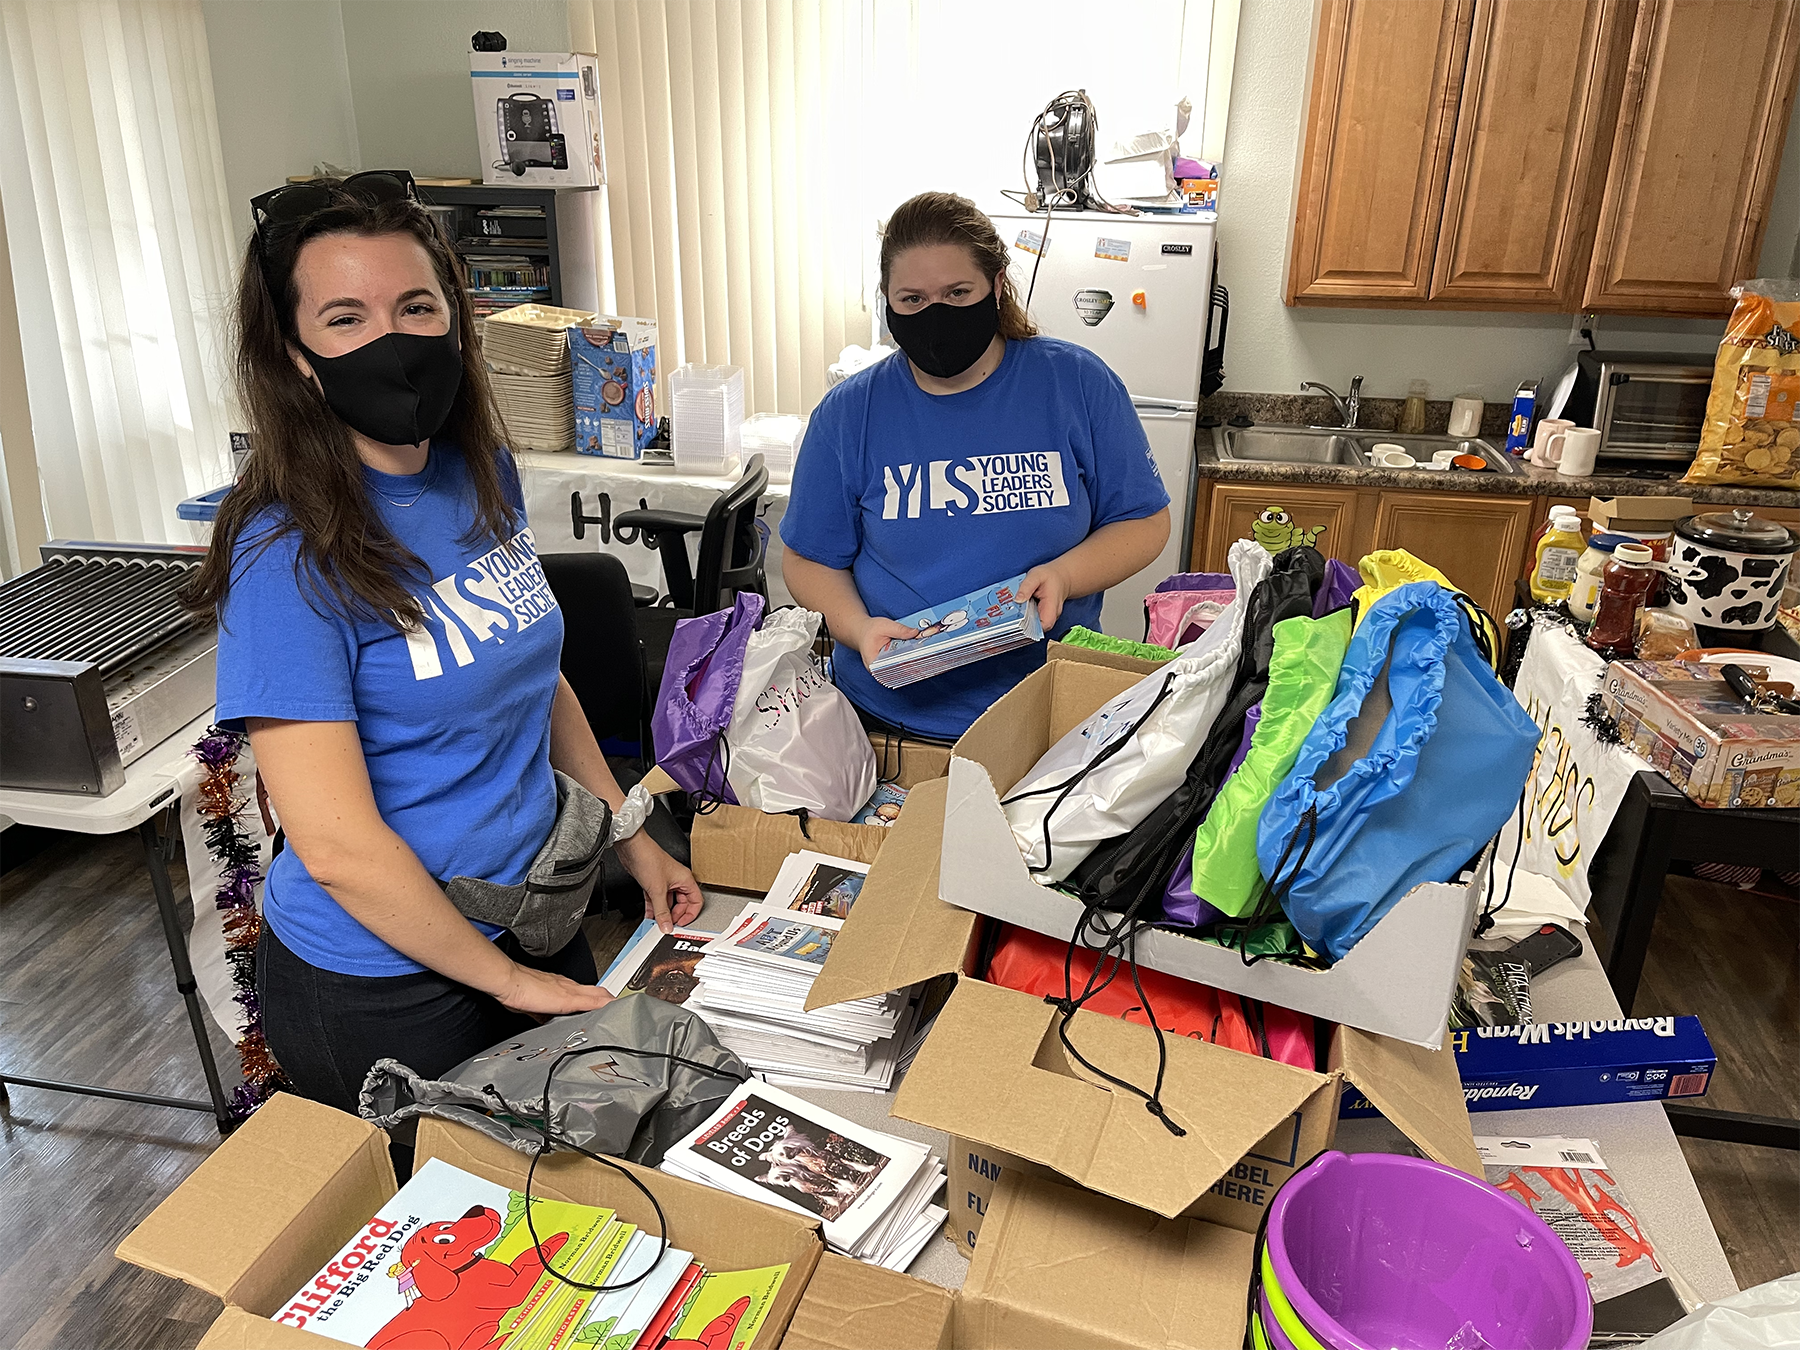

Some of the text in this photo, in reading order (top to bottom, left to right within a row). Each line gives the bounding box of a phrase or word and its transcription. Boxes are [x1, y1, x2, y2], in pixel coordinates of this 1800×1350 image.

[976, 453, 1049, 477] YOUNG
[981, 474, 1053, 494] LEADERS
[983, 490, 1056, 512] SOCIETY
[477, 532, 537, 584] YOUNG
[497, 560, 546, 605] LEADER
[1609, 679, 1647, 706] Grandma's
[1666, 719, 1684, 740] Variety
[1695, 738, 1706, 753] 36
[1731, 751, 1789, 767] Grandma's
[672, 940, 700, 952] Ba
[1490, 966, 1507, 994] GARLIC
[1503, 962, 1530, 988] PITA
[1554, 1016, 1677, 1041] Reynolds
[1462, 1082, 1540, 1102] Reynolds
[706, 1108, 766, 1154] Breeds
[731, 1115, 790, 1167] of Dogs
[967, 1191, 989, 1217] FL
[1209, 1180, 1266, 1206] HERE
[558, 1214, 604, 1270] Norman Bridwell
[605, 1230, 627, 1263] Bridwell
[317, 1215, 421, 1322] the Big Red Dog
[515, 1280, 552, 1323] SCHOLASTIC
[746, 1271, 781, 1330] Norman Bridwell
[551, 1299, 583, 1348] SCHOLASTIC
